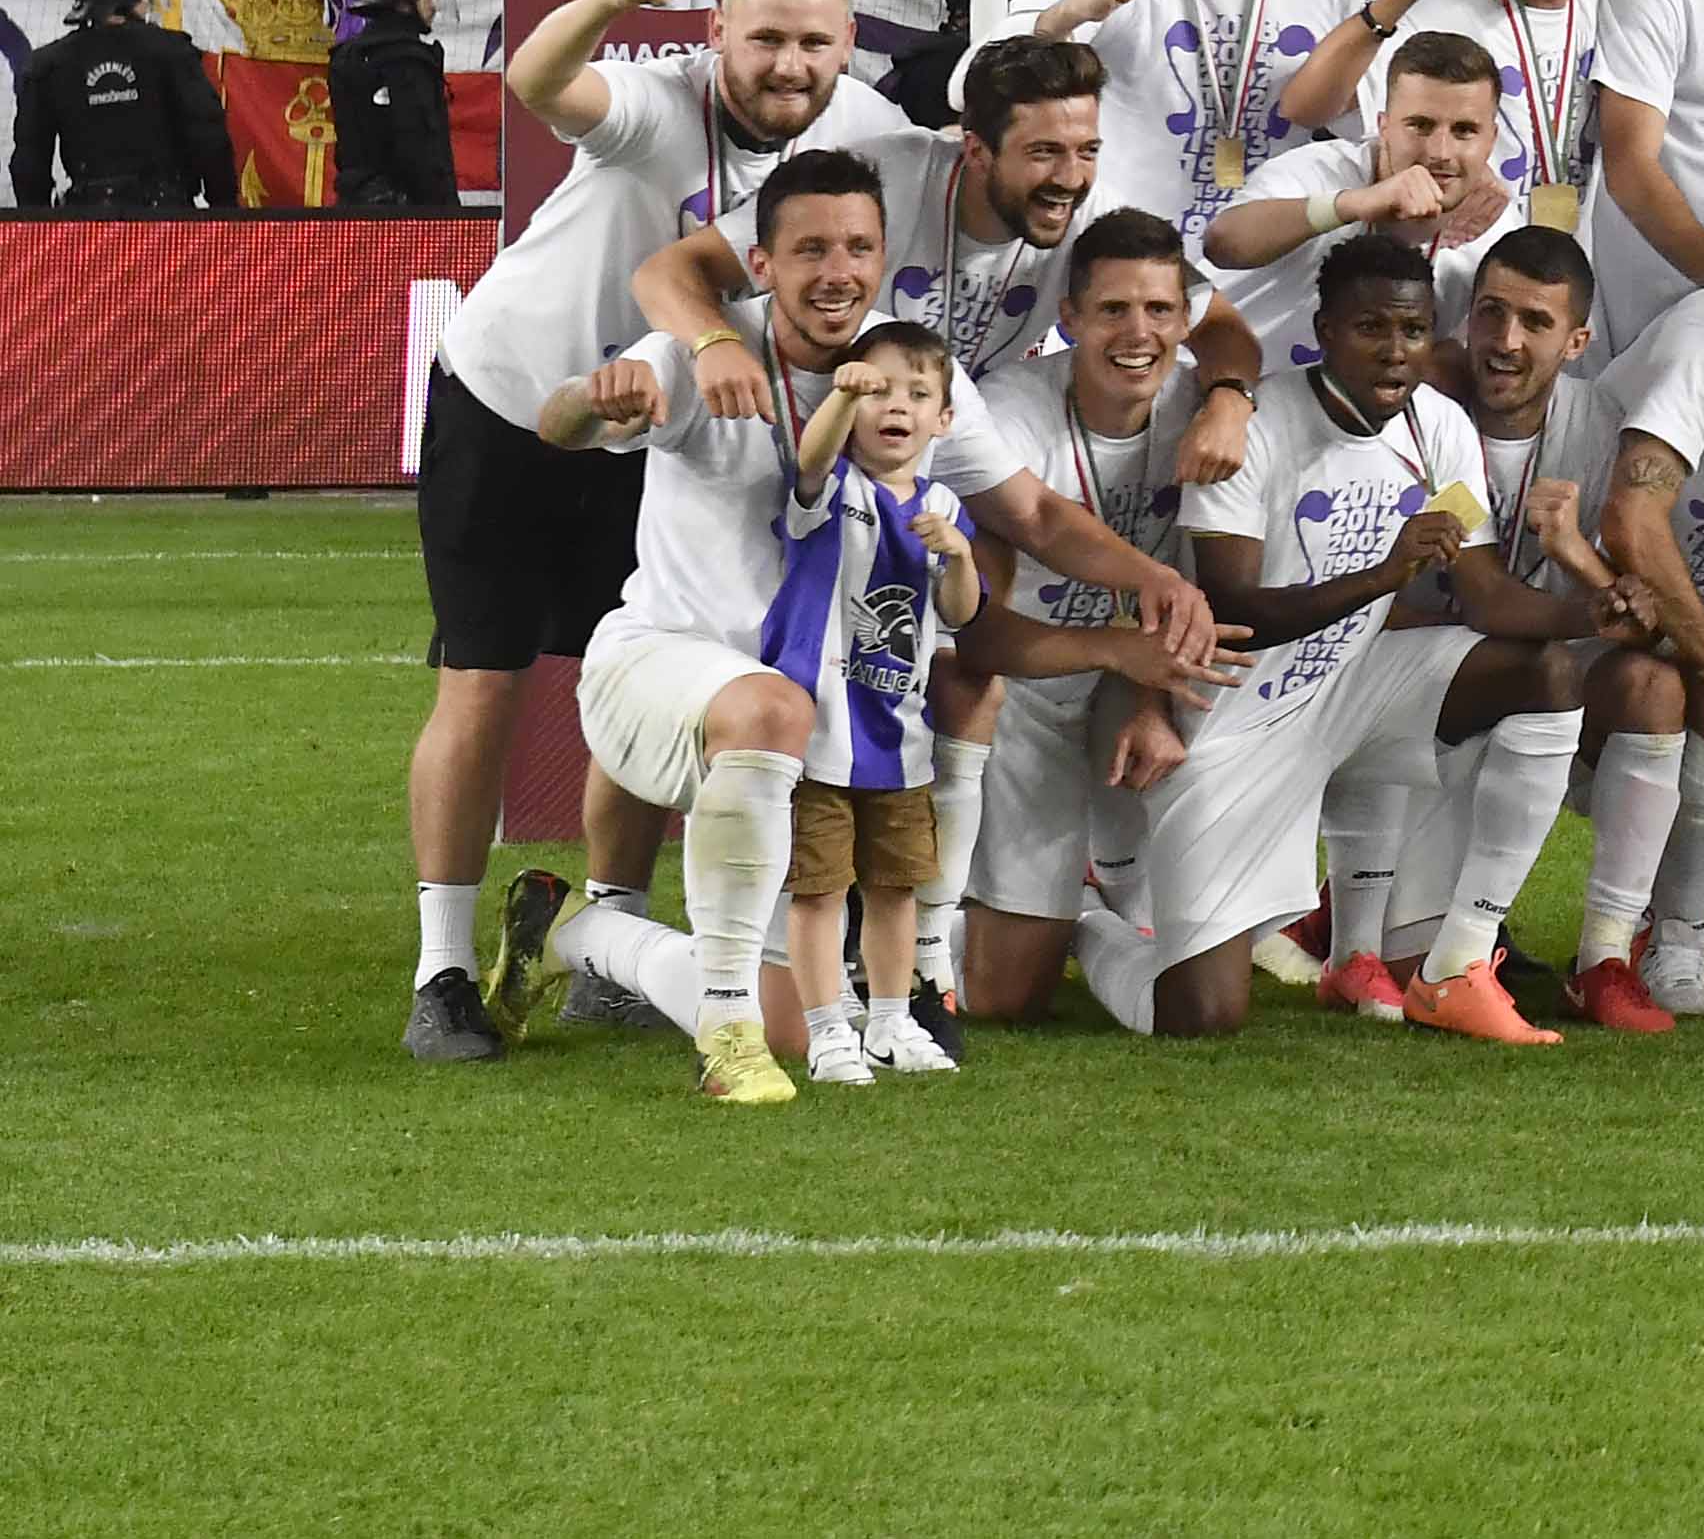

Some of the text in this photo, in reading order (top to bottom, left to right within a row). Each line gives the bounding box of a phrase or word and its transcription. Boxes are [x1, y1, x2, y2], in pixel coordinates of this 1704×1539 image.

[1330, 479, 1402, 511] 2018
[1328, 508, 1401, 534] 2014
[1327, 531, 1389, 554] 2002
[1294, 642, 1352, 661] 1975
